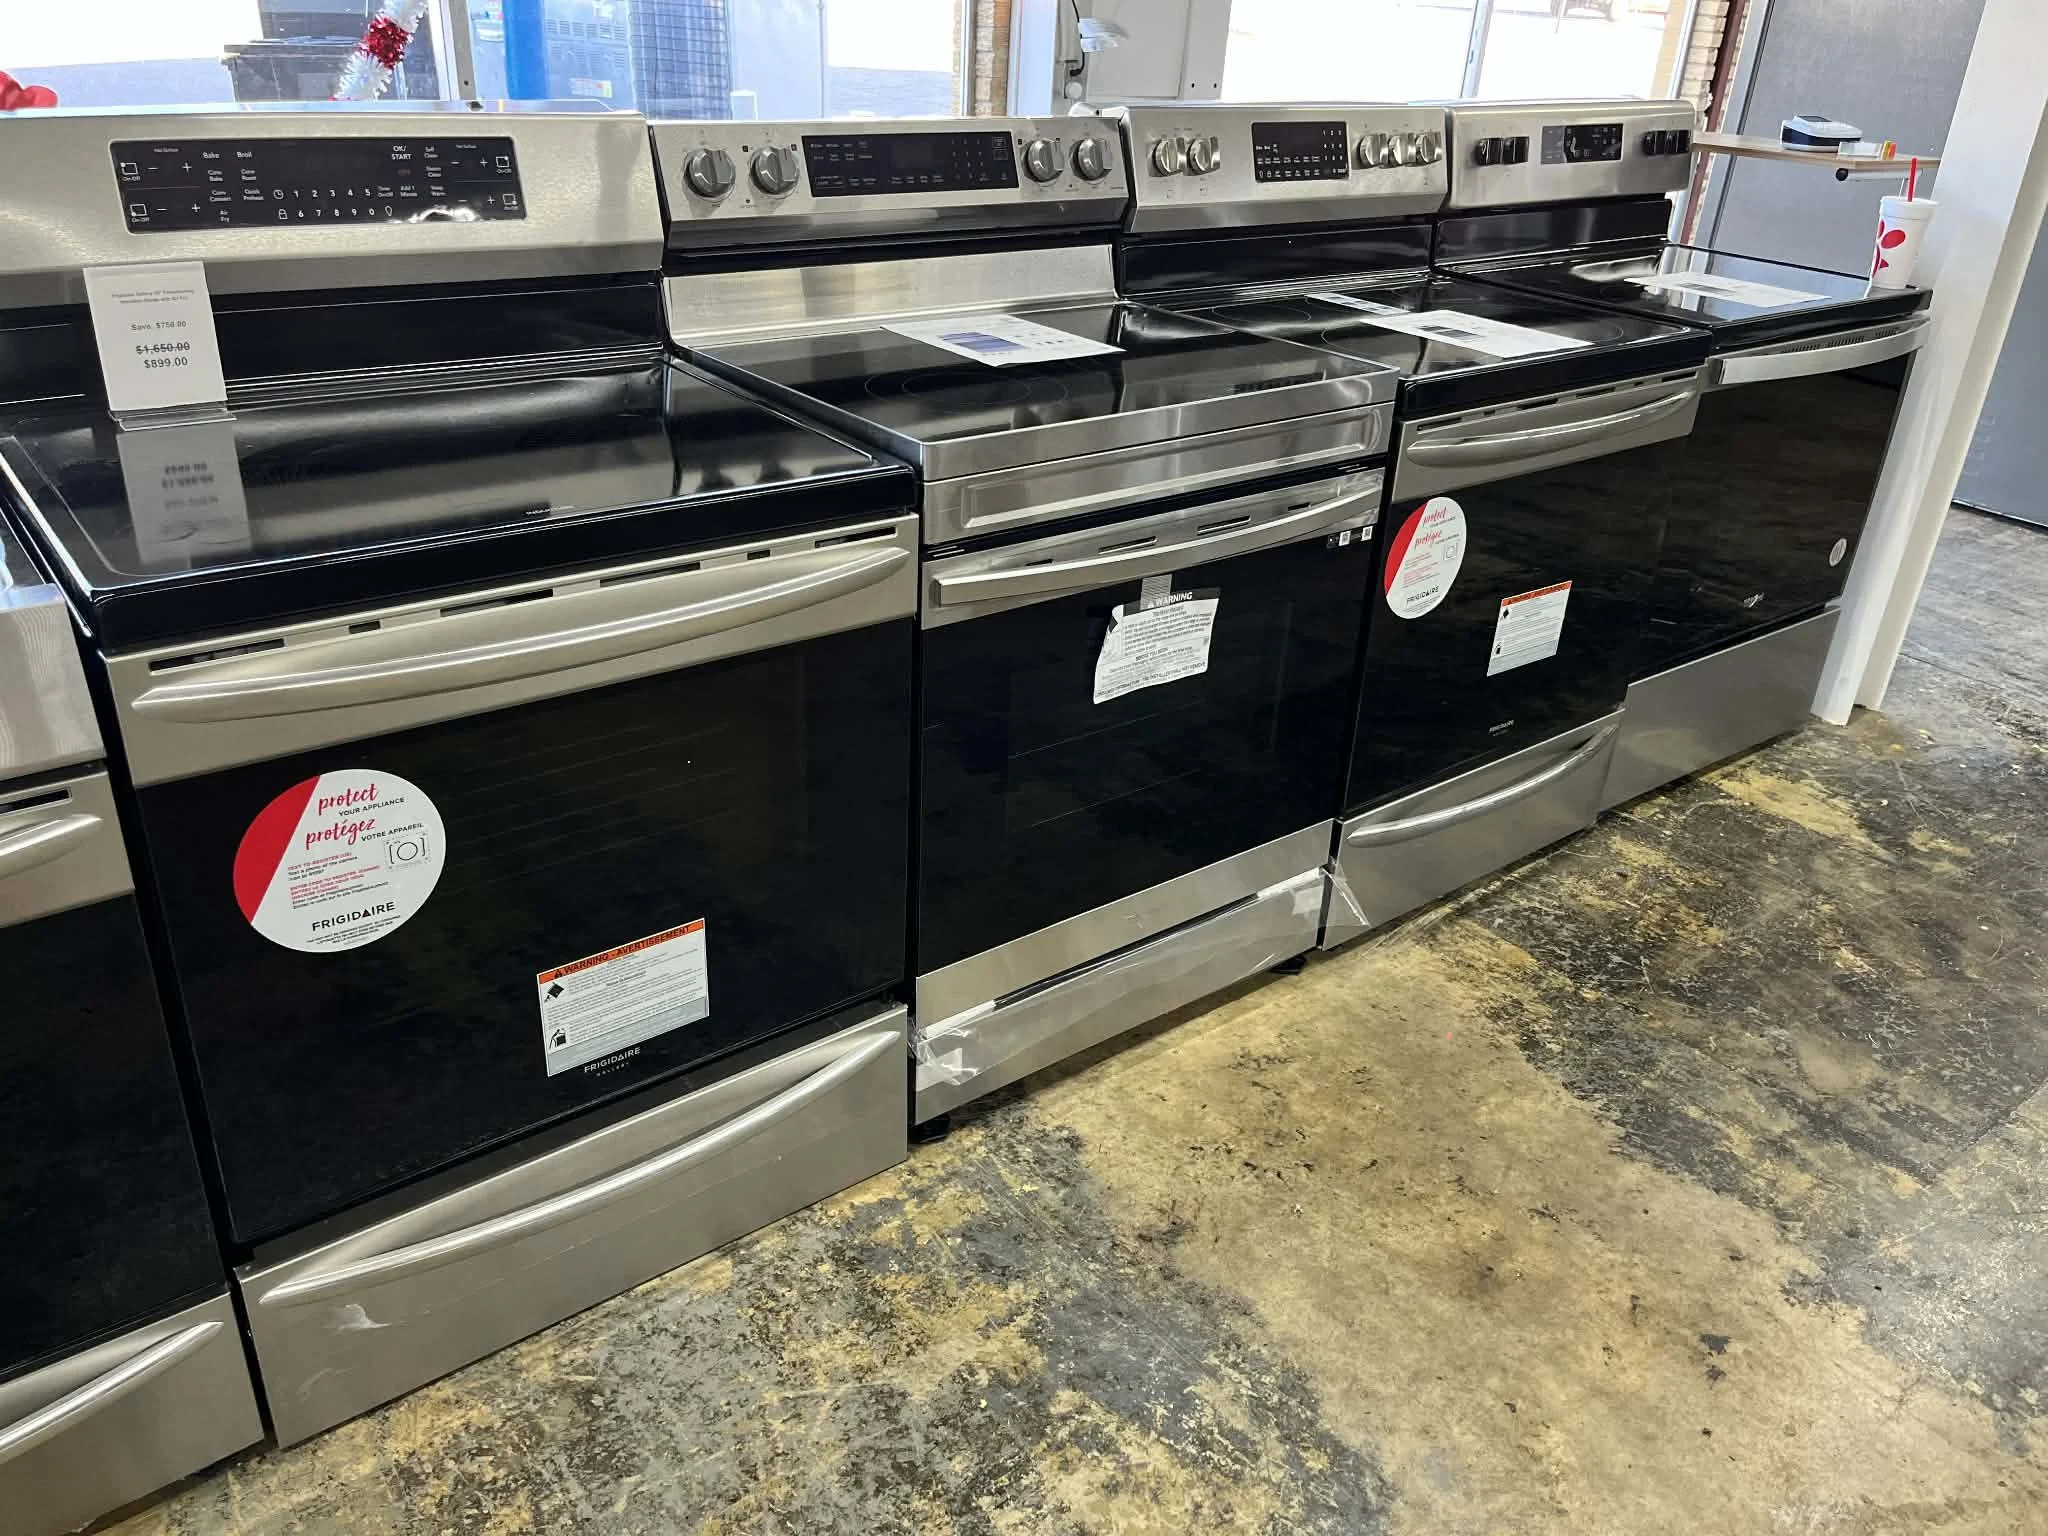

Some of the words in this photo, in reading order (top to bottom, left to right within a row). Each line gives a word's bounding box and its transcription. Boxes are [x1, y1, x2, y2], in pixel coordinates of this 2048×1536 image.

[236, 151, 253, 159] Broil
[293, 190, 299, 198] 1
[312, 189, 318, 197] 2
[329, 189, 336, 197] 3
[347, 188, 353, 196] 4
[364, 188, 371, 197] 5
[298, 209, 304, 217] 6
[334, 208, 340, 217] 8
[351, 208, 357, 216] 9
[368, 207, 375, 215] 0
[136, 341, 190, 355] $1,650.00
[144, 356, 188, 369] $899.00
[1156, 591, 1193, 607] WARNING
[318, 783, 379, 816] protect
[338, 807, 361, 818] YOUR
[362, 797, 406, 812] APPLIANCE
[305, 818, 377, 850] protégez
[361, 831, 387, 842] VOTRE
[388, 822, 425, 835] APPAREIL
[311, 901, 396, 932] FRIGIDAIRE
[565, 952, 609, 974] WARNING
[617, 925, 690, 955] AVERTISSEMENT
[583, 1047, 642, 1074] FRIGIDAIRE
